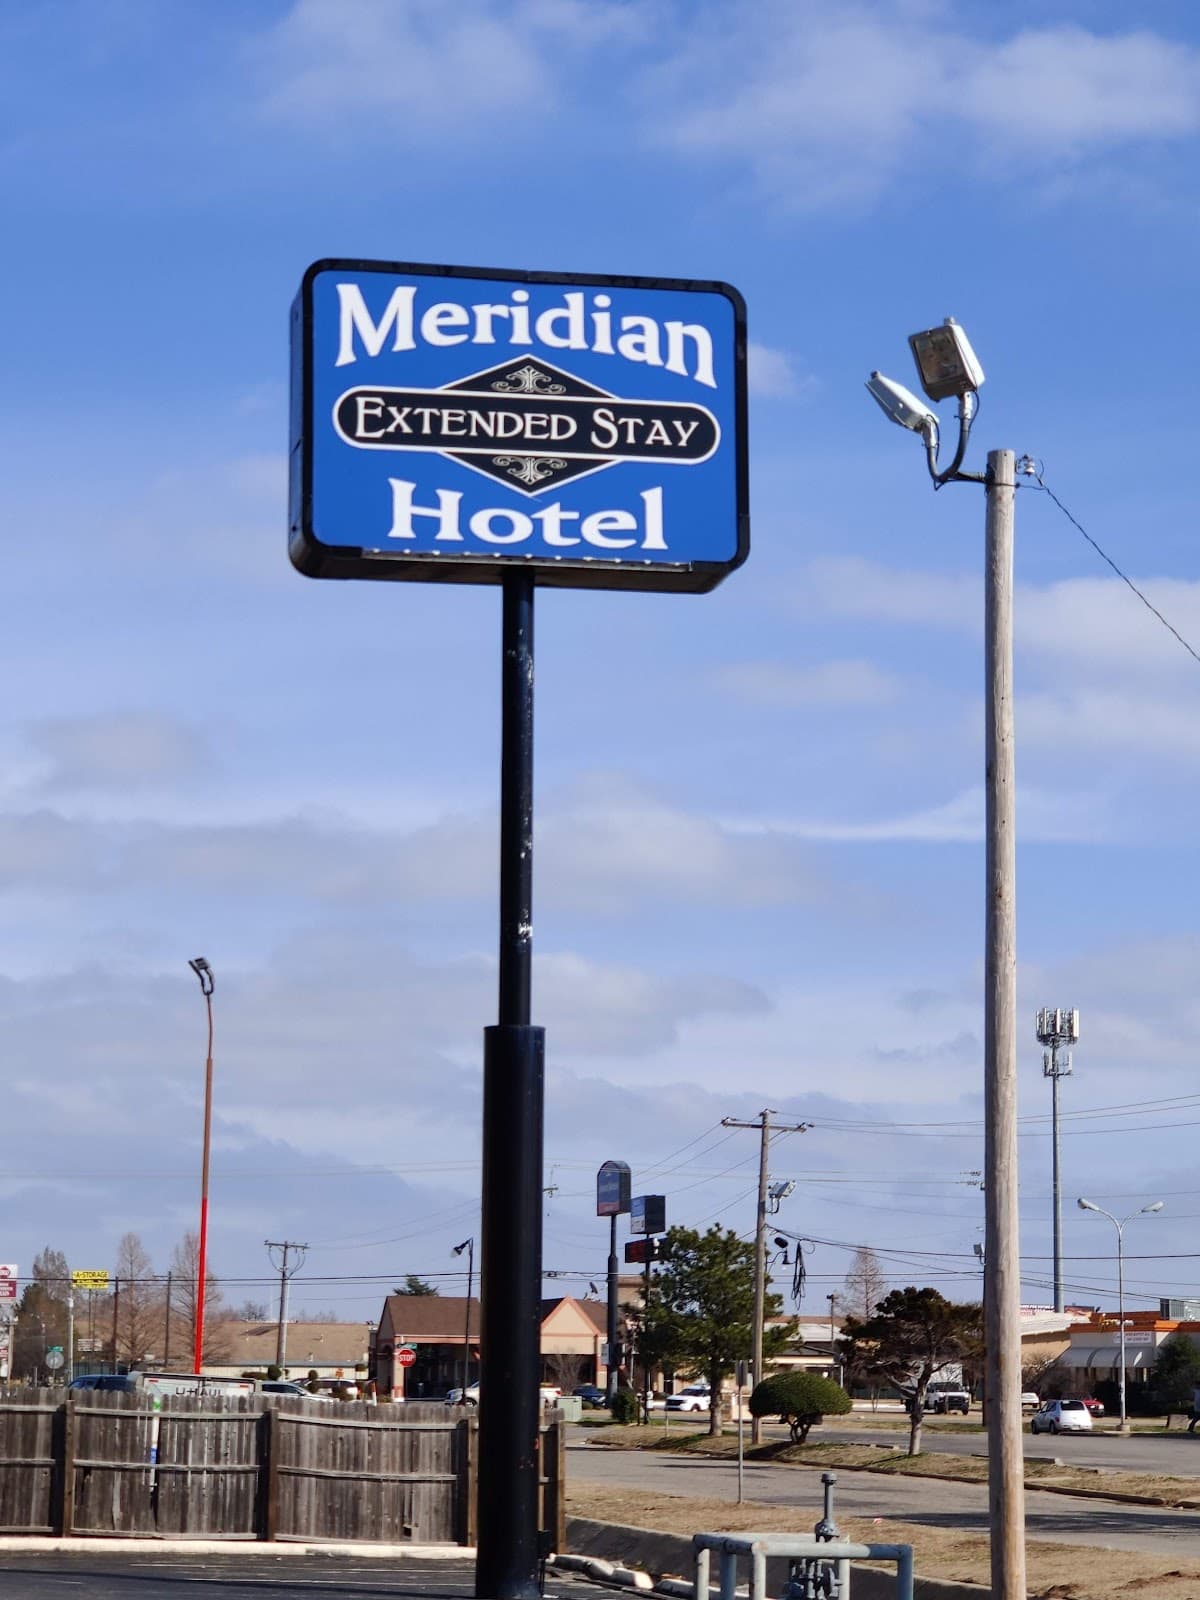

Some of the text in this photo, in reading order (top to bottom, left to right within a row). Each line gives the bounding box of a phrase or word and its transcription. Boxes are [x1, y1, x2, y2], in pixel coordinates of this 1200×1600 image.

[335, 283, 717, 389] Meridian
[355, 396, 699, 448] EXTENDED STAY
[387, 478, 669, 550] Hotel
